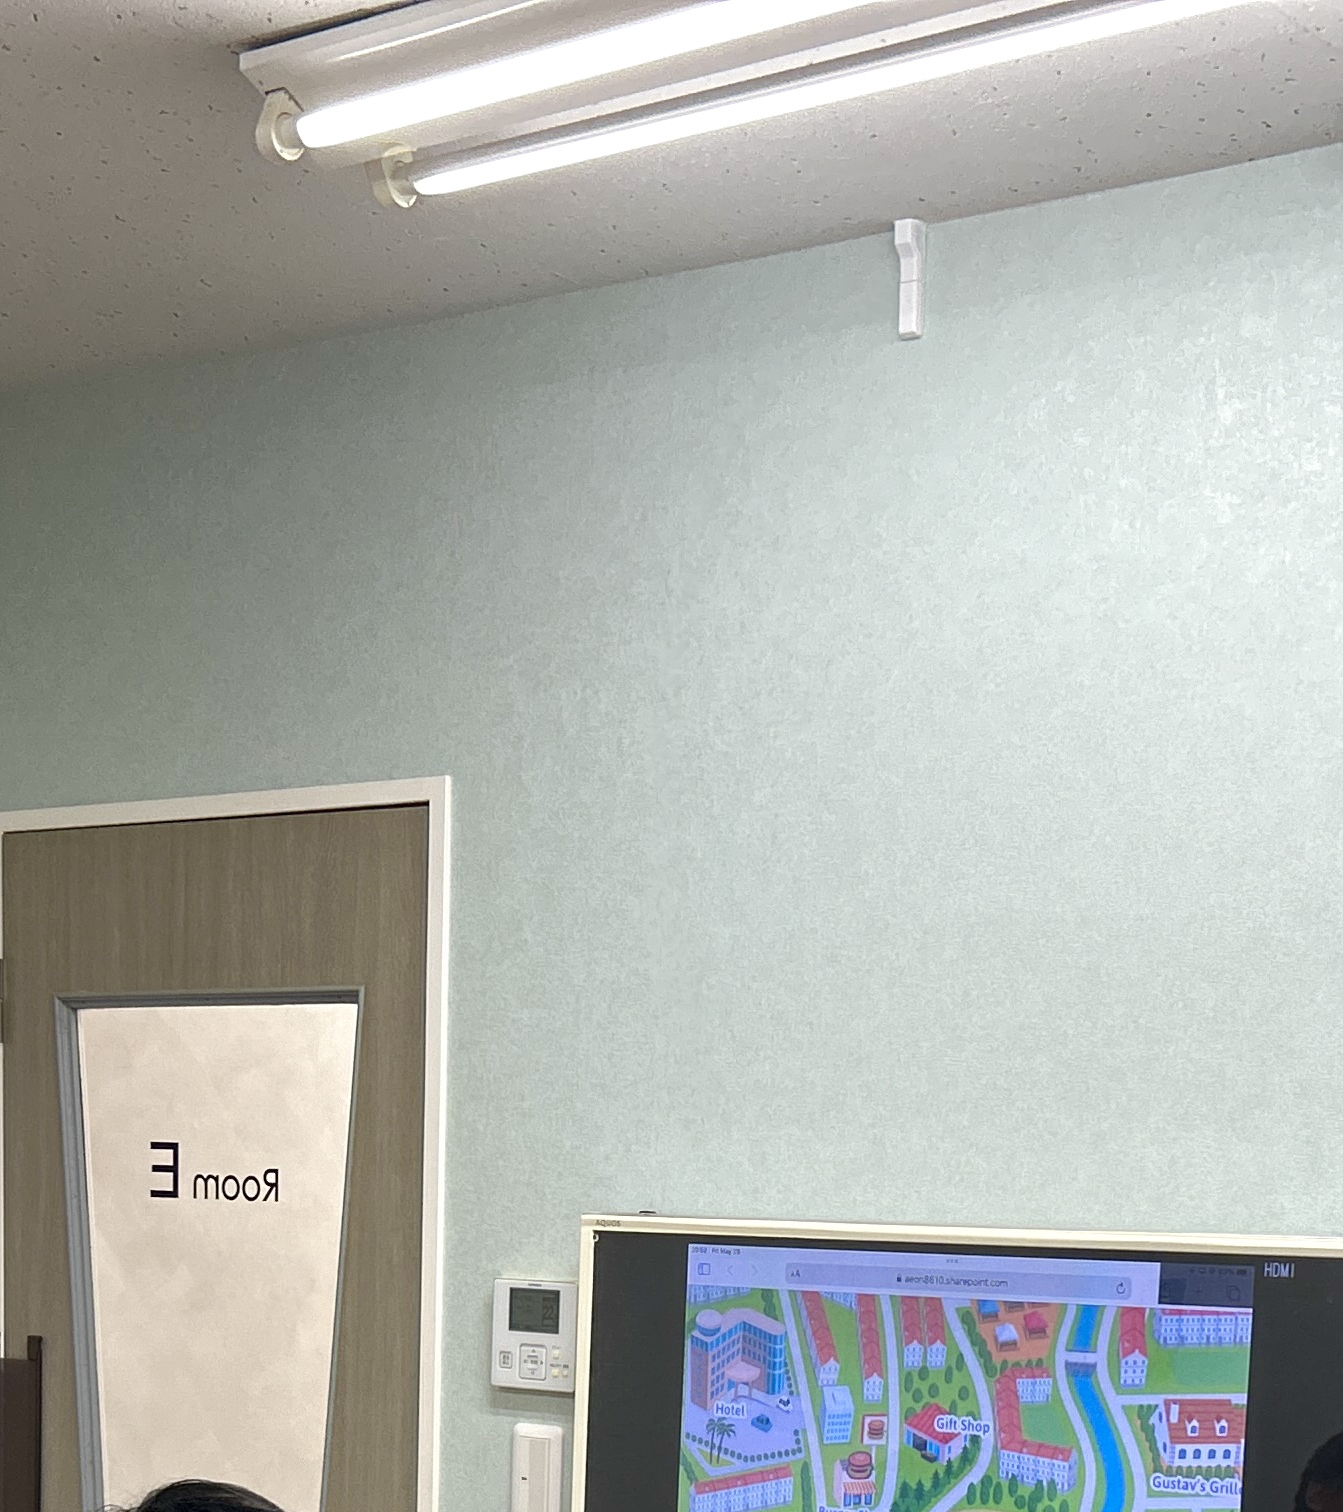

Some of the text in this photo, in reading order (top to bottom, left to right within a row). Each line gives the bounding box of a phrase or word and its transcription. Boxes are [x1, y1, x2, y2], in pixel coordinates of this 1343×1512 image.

[1263, 1262, 1295, 1279] HDMI
[715, 1404, 746, 1417] Hotel
[936, 1417, 990, 1435] Gift Shop
[1153, 1475, 1206, 1493] Gustav's
